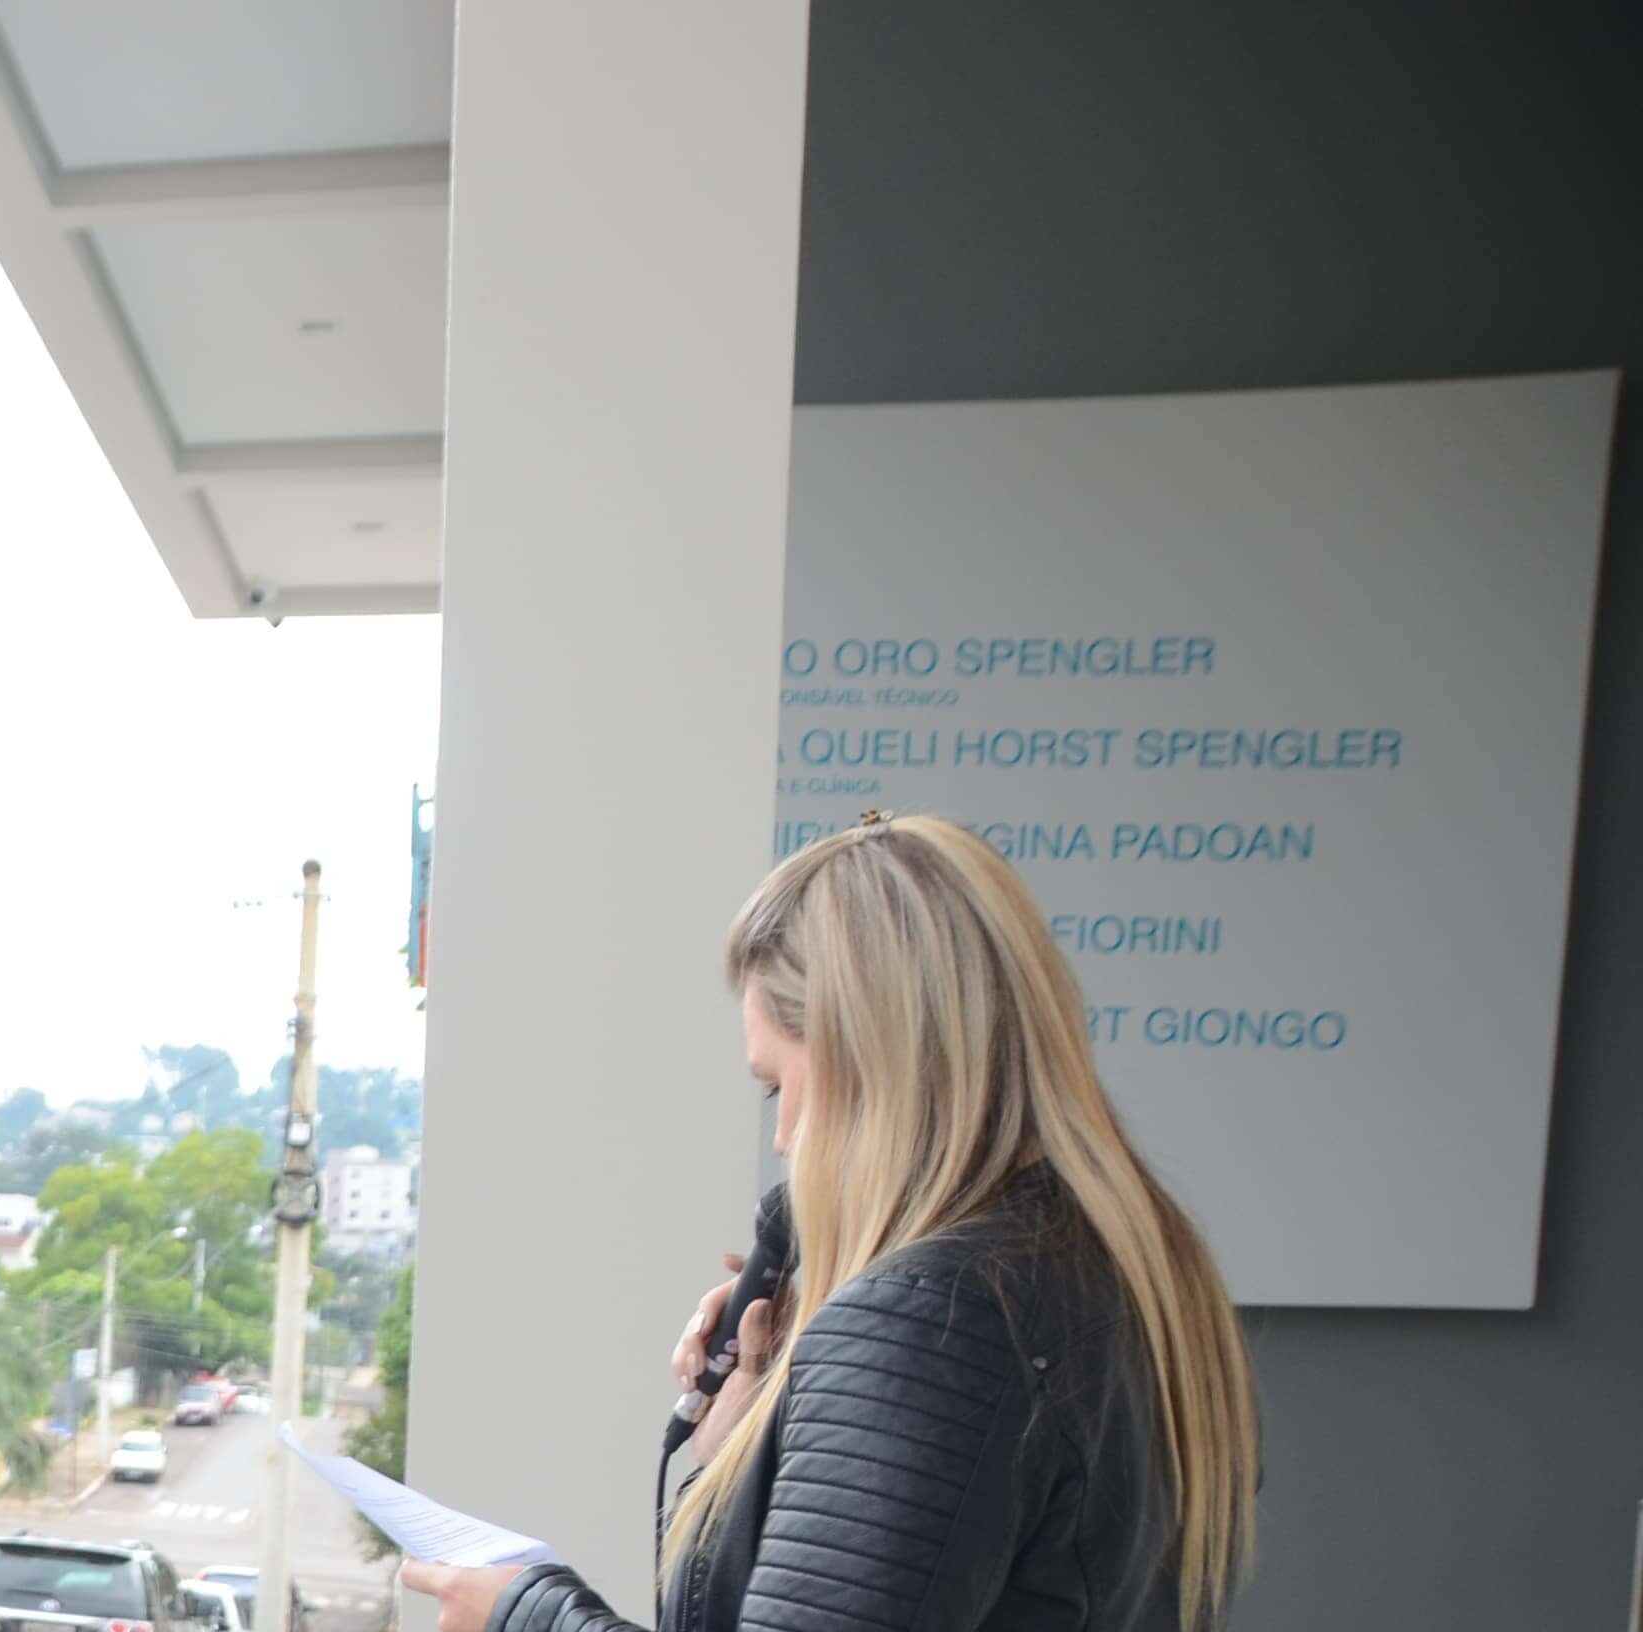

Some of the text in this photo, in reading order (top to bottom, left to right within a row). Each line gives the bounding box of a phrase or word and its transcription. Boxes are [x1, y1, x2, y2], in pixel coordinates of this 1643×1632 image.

[834, 638, 940, 677] ORO
[955, 636, 1217, 677] SPENGLER
[801, 728, 938, 769] QUELI
[953, 728, 1122, 768] HORST
[1134, 728, 1403, 769] SPENGLER
[1110, 823, 1315, 862] PADOAN
[1050, 914, 1223, 956] FIORINI
[1144, 1008, 1348, 1051] GIONGO
